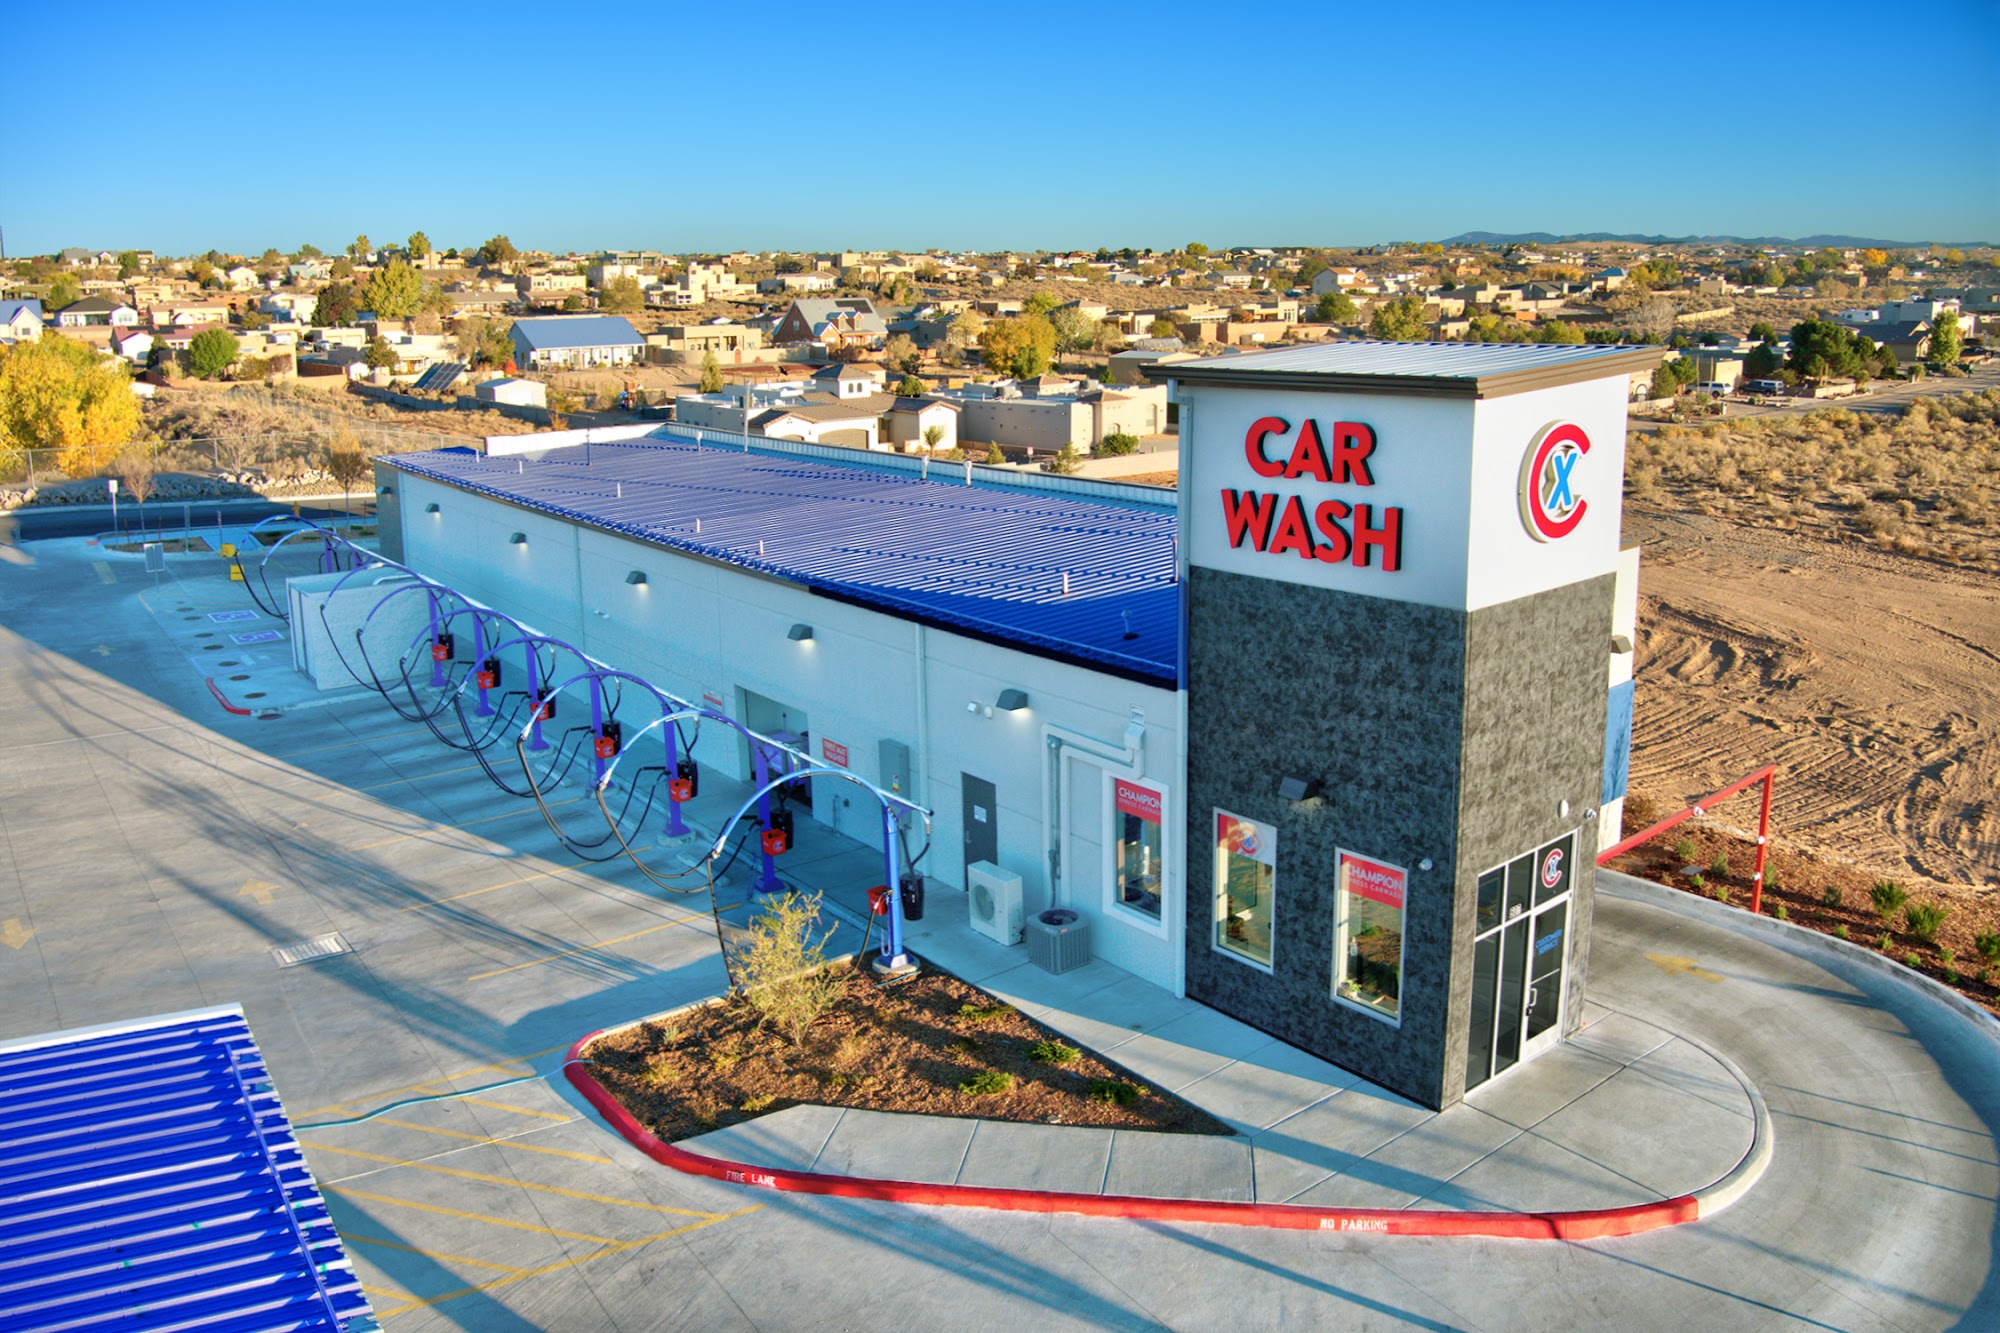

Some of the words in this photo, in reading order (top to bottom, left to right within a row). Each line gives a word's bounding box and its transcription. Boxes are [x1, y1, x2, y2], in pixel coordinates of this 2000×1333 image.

[1245, 416, 1377, 486] CAR
[1220, 489, 1403, 572] WASH
[1118, 786, 1161, 809] CHAMPION
[1345, 862, 1403, 892] CHAMPION
[726, 1170, 745, 1182] FIRE
[751, 1173, 776, 1187] LANE
[1320, 1218, 1335, 1229] NO
[1341, 1219, 1388, 1231] PARKING
